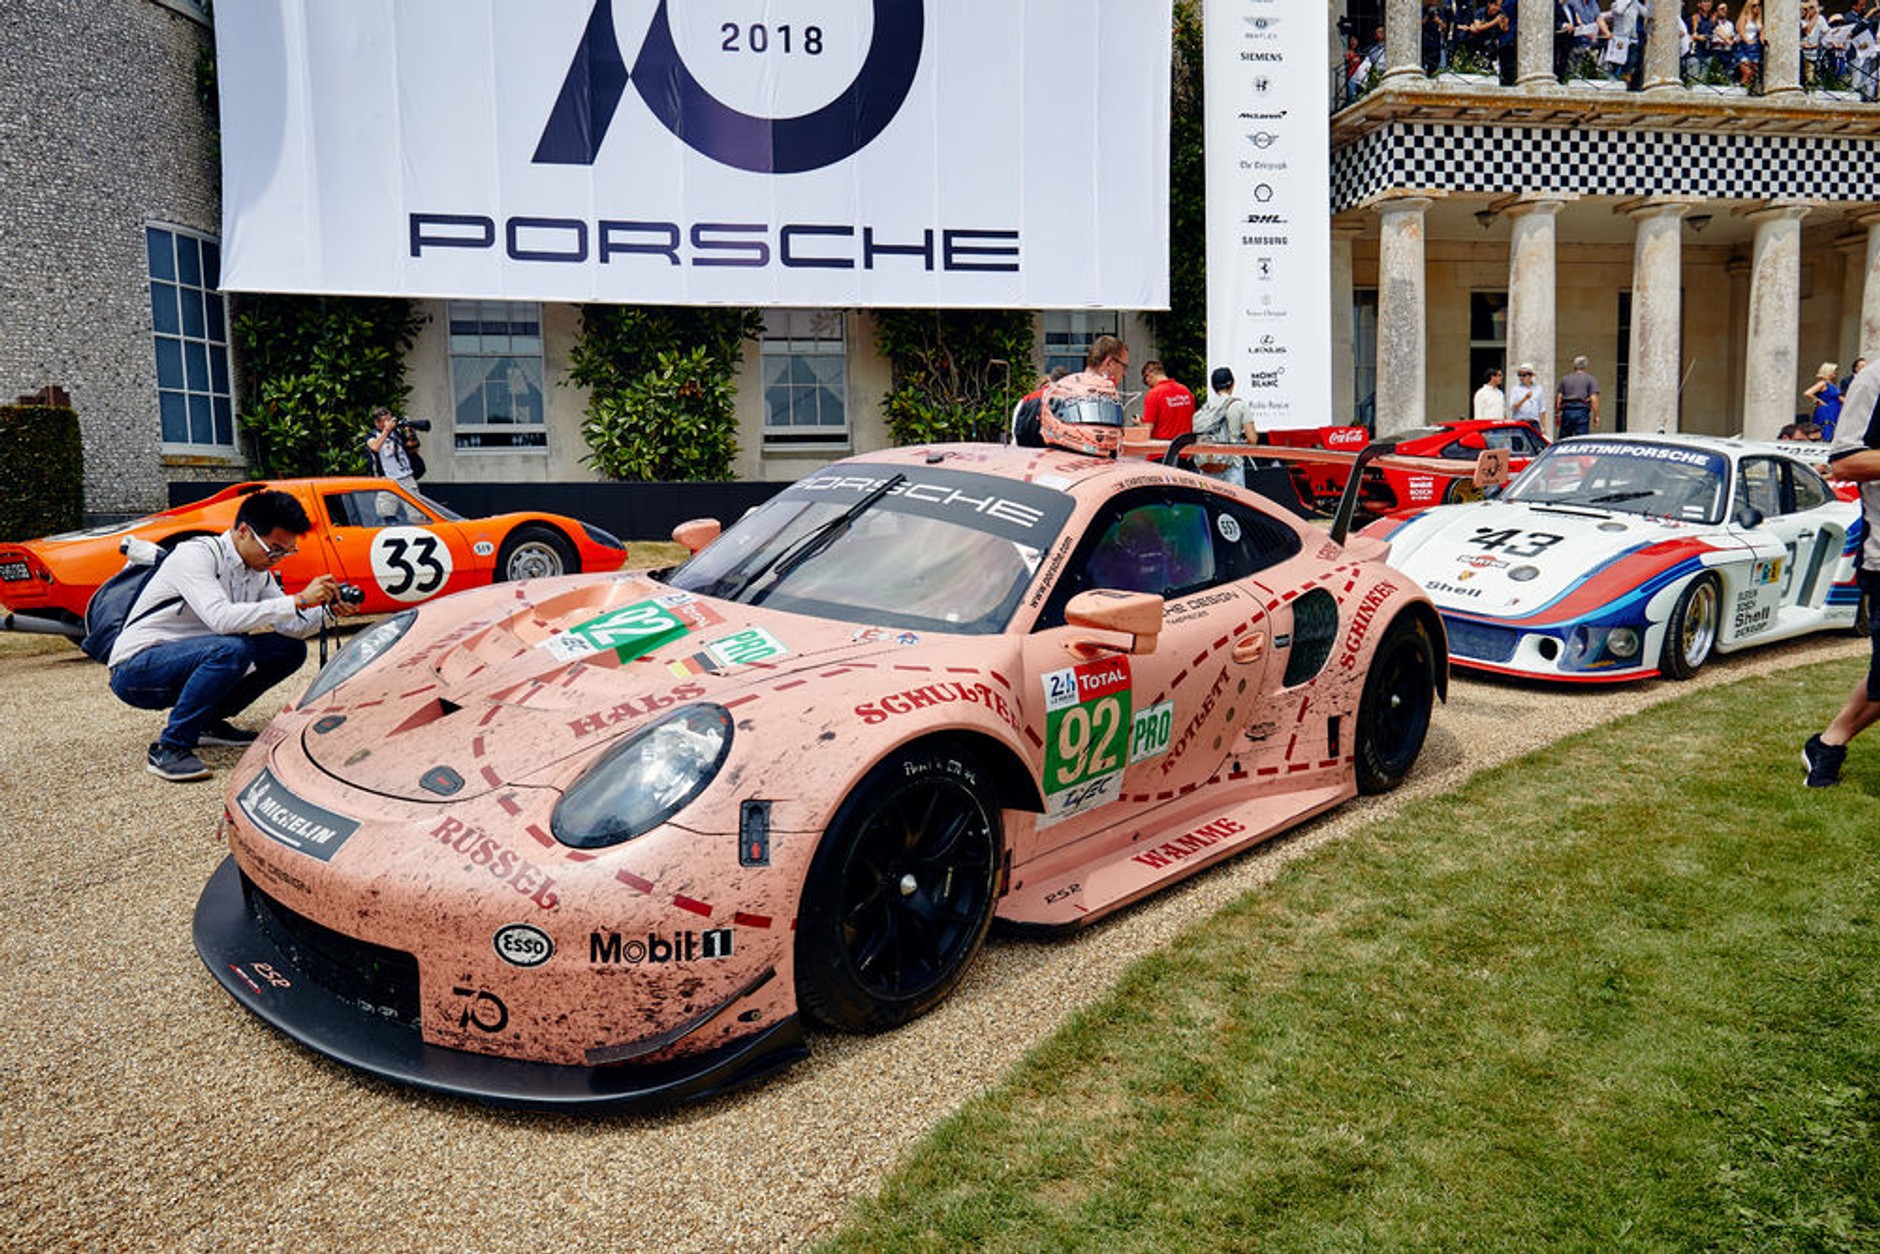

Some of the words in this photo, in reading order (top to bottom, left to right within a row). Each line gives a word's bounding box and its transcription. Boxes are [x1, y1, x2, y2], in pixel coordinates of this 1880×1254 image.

[720, 21, 825, 56] 2018
[1240, 52, 1283, 62] SIEMENS
[1247, 214, 1281, 224] DHL
[409, 211, 1020, 273] PORSCHE
[1242, 235, 1288, 246] SAMSUNG
[1251, 379, 1278, 388] BLANC
[382, 536, 445, 595] 33
[1424, 580, 1482, 598] Shell
[1735, 605, 1770, 628] Shell
[706, 629, 777, 664] PRO
[1079, 668, 1128, 691] TOTAL
[568, 682, 707, 739] HALS
[1056, 696, 1122, 786] 92
[1132, 709, 1172, 757] PRO
[258, 796, 337, 844] MICHELIN
[1130, 816, 1247, 871] WAMME
[589, 931, 697, 965] Mobil
